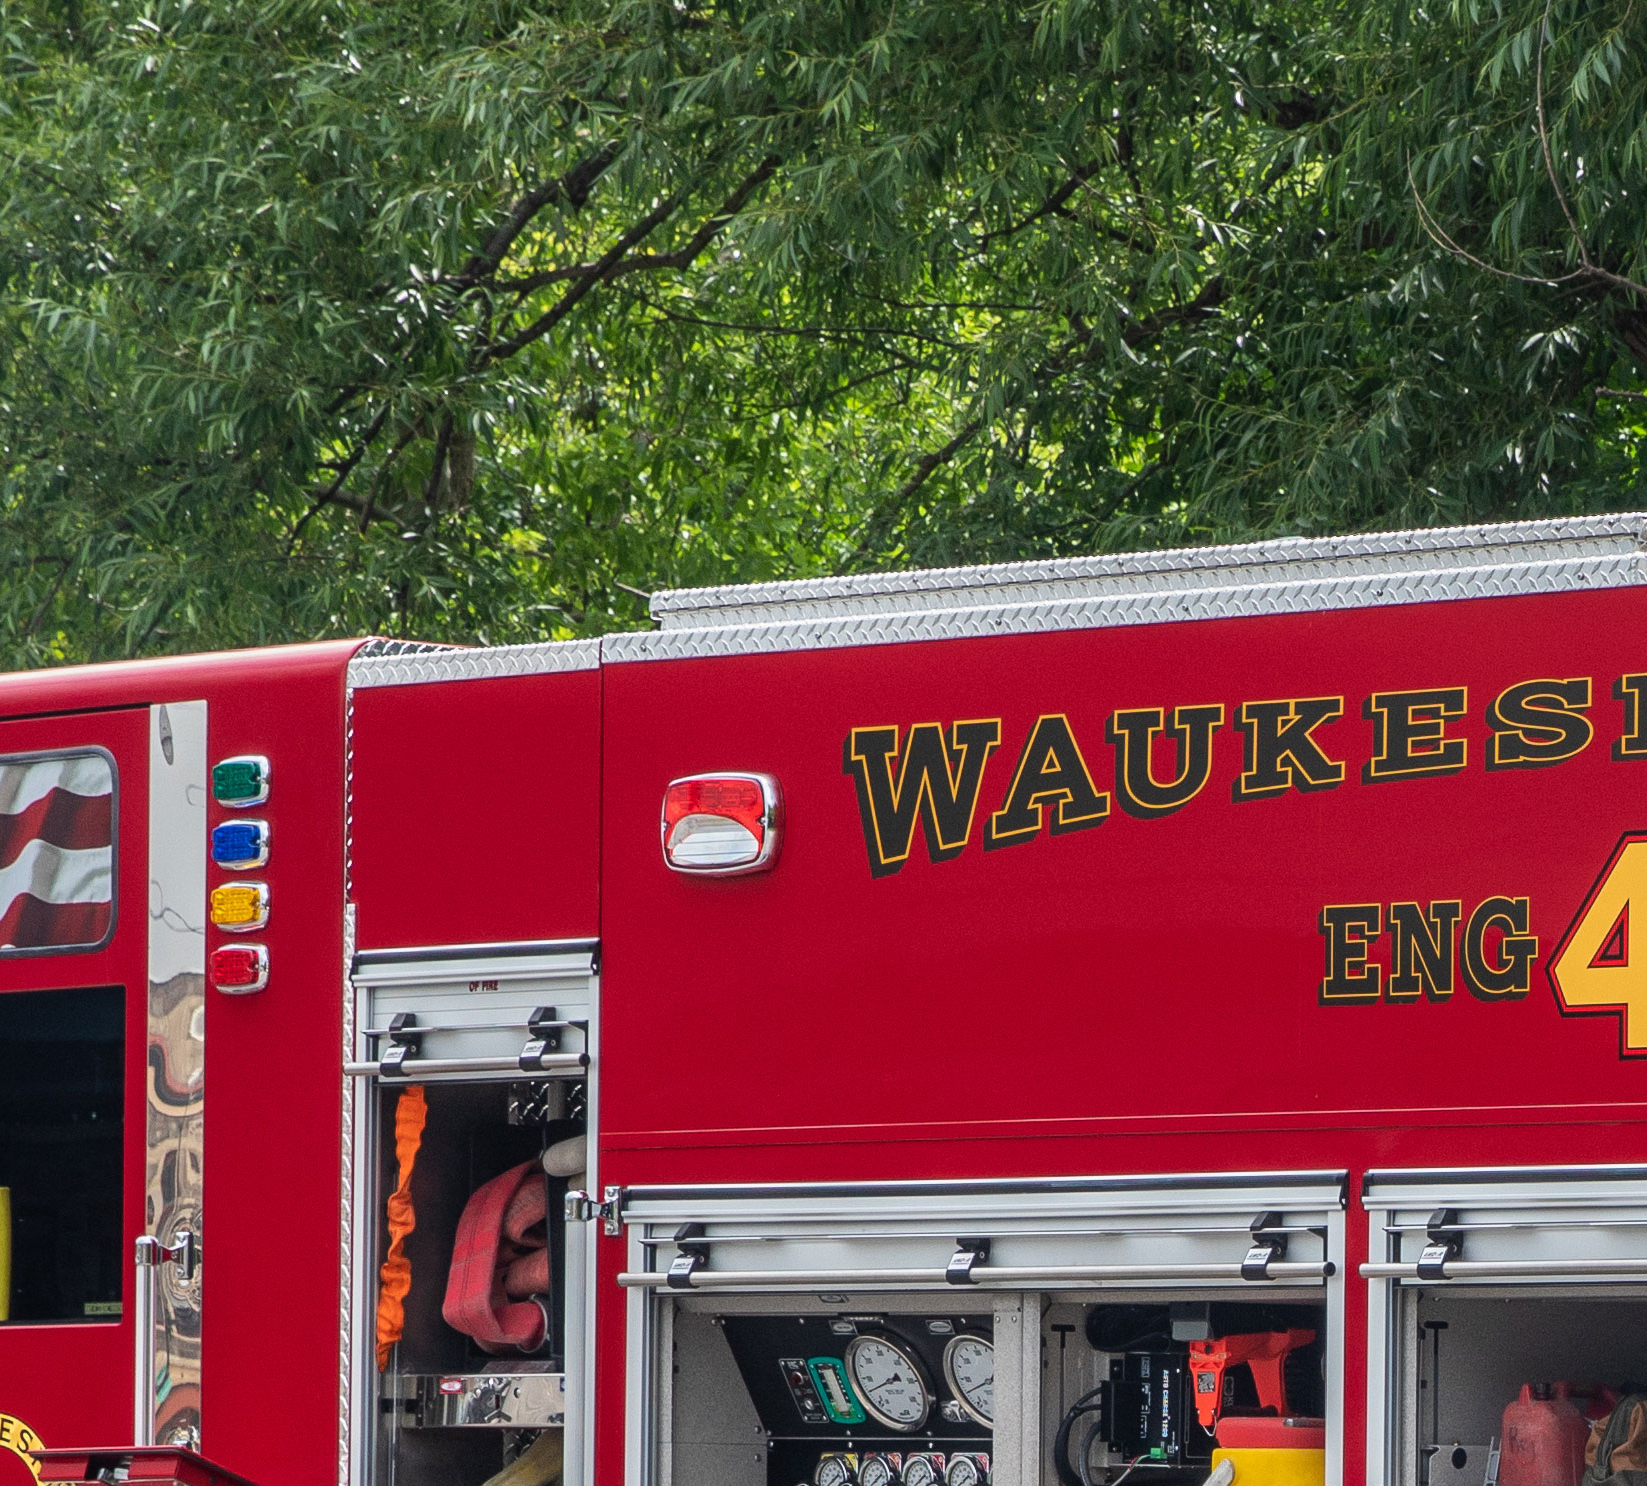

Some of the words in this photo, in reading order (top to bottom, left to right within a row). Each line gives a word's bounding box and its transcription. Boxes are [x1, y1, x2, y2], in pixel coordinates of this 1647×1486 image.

[1317, 896, 1539, 1007] ENG
[468, 981, 480, 992] OF
[482, 980, 499, 992] FIRE
